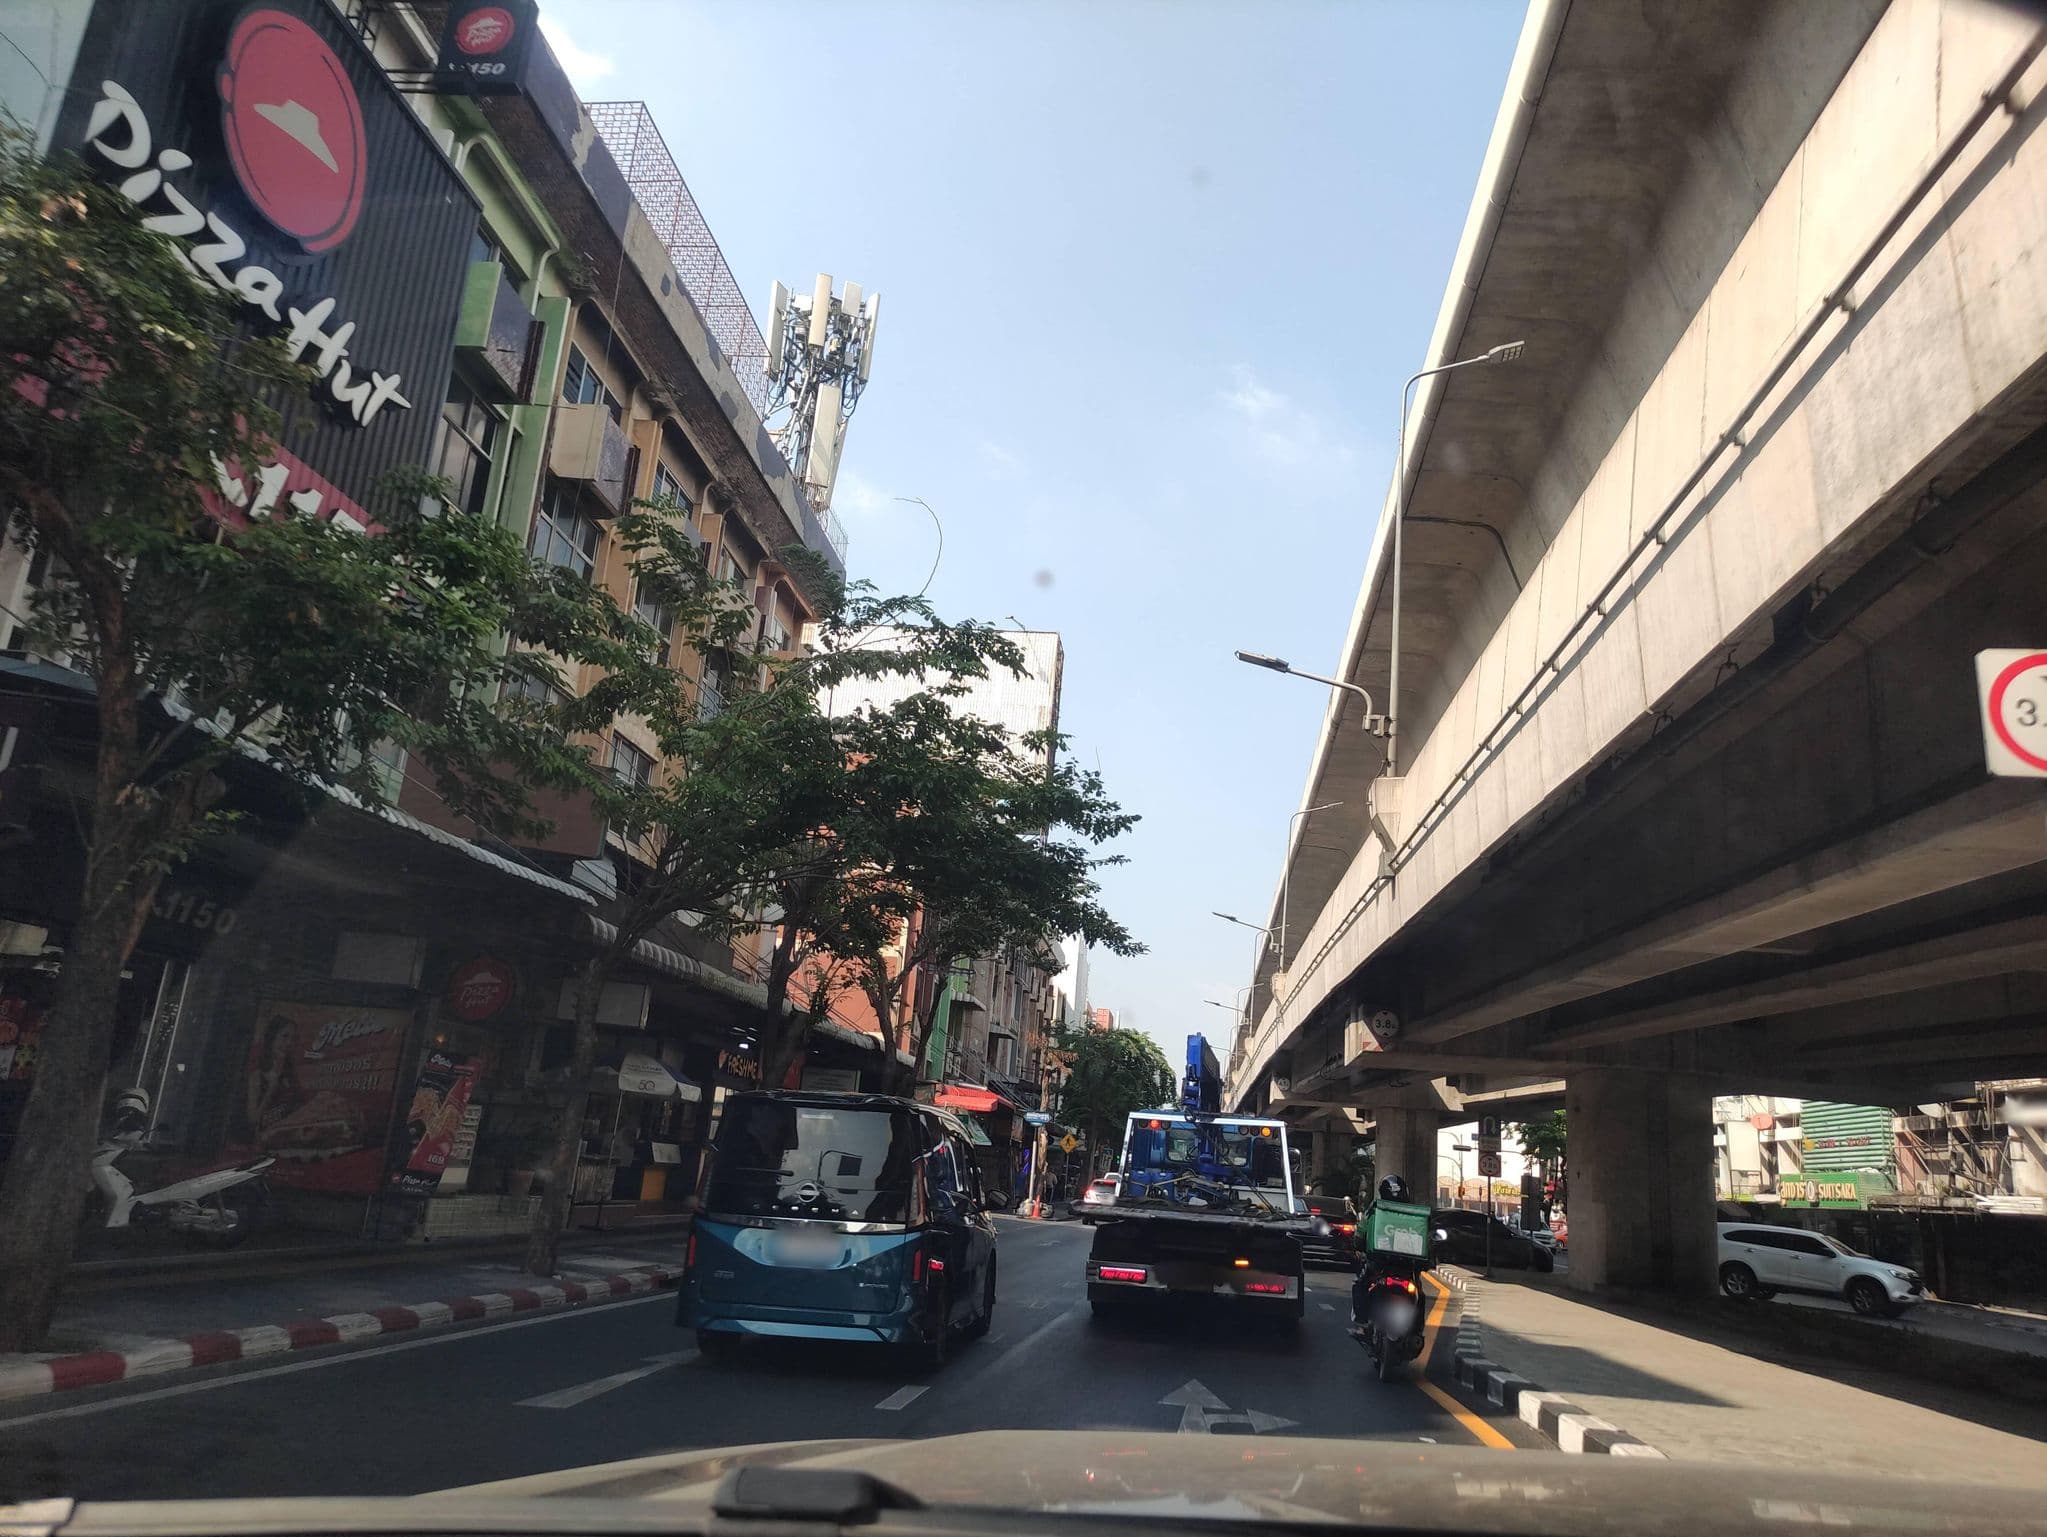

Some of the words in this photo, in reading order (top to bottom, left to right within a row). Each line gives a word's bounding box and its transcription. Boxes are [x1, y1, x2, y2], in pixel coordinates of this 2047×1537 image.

[465, 61, 507, 76] 150
[83, 79, 286, 322] Pizza
[287, 296, 413, 428] Hut
